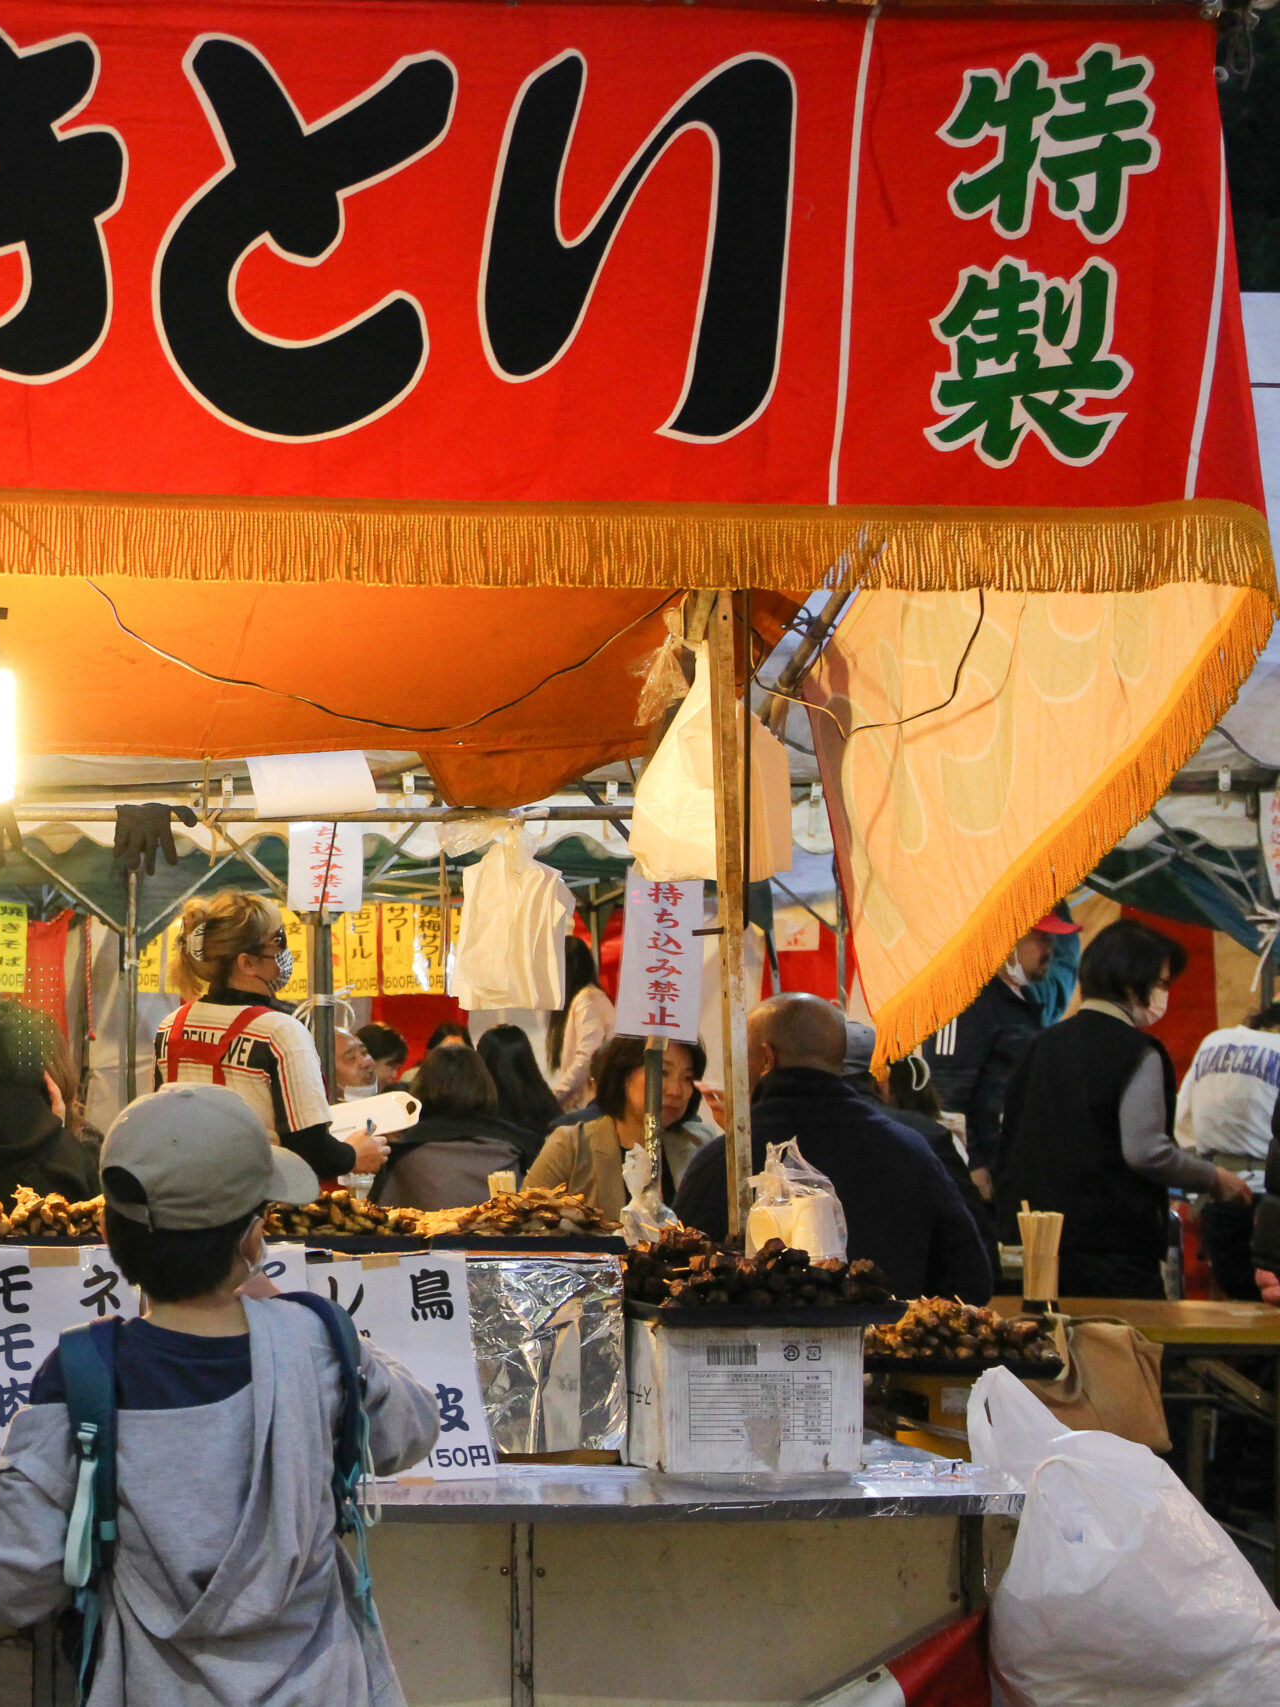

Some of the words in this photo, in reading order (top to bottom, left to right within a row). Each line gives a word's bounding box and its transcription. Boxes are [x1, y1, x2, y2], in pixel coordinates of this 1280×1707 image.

[923, 42, 1161, 470] 特製
[309, 826, 344, 905] ち込み禁止
[387, 905, 408, 942] サワー
[641, 881, 684, 1028] 持ち込み禁止
